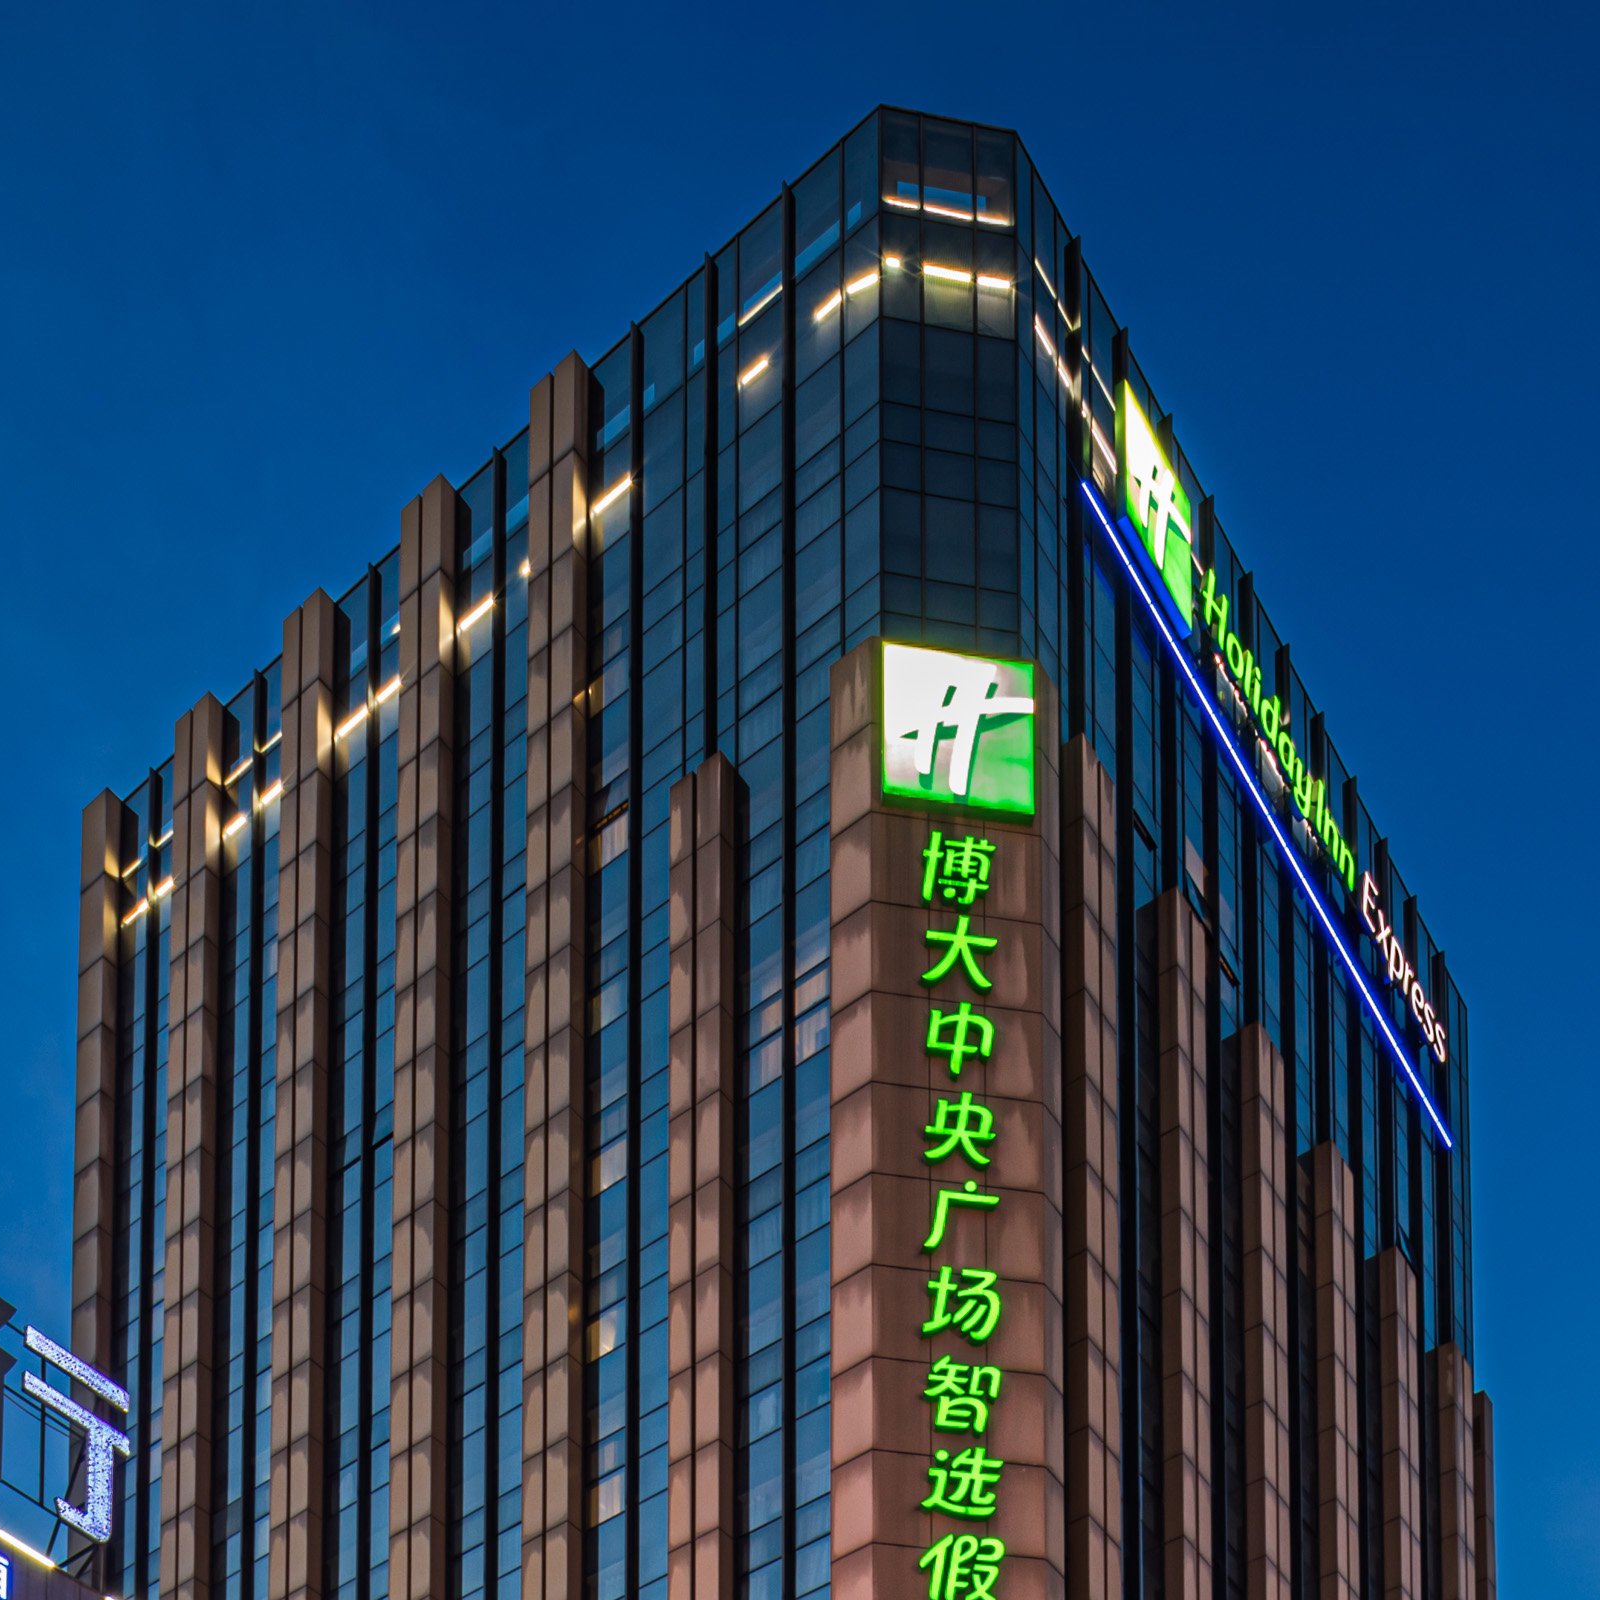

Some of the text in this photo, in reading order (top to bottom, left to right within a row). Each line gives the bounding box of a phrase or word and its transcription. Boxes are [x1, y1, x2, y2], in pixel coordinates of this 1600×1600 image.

[1203, 567, 1447, 1064] Holiday Inn Express
